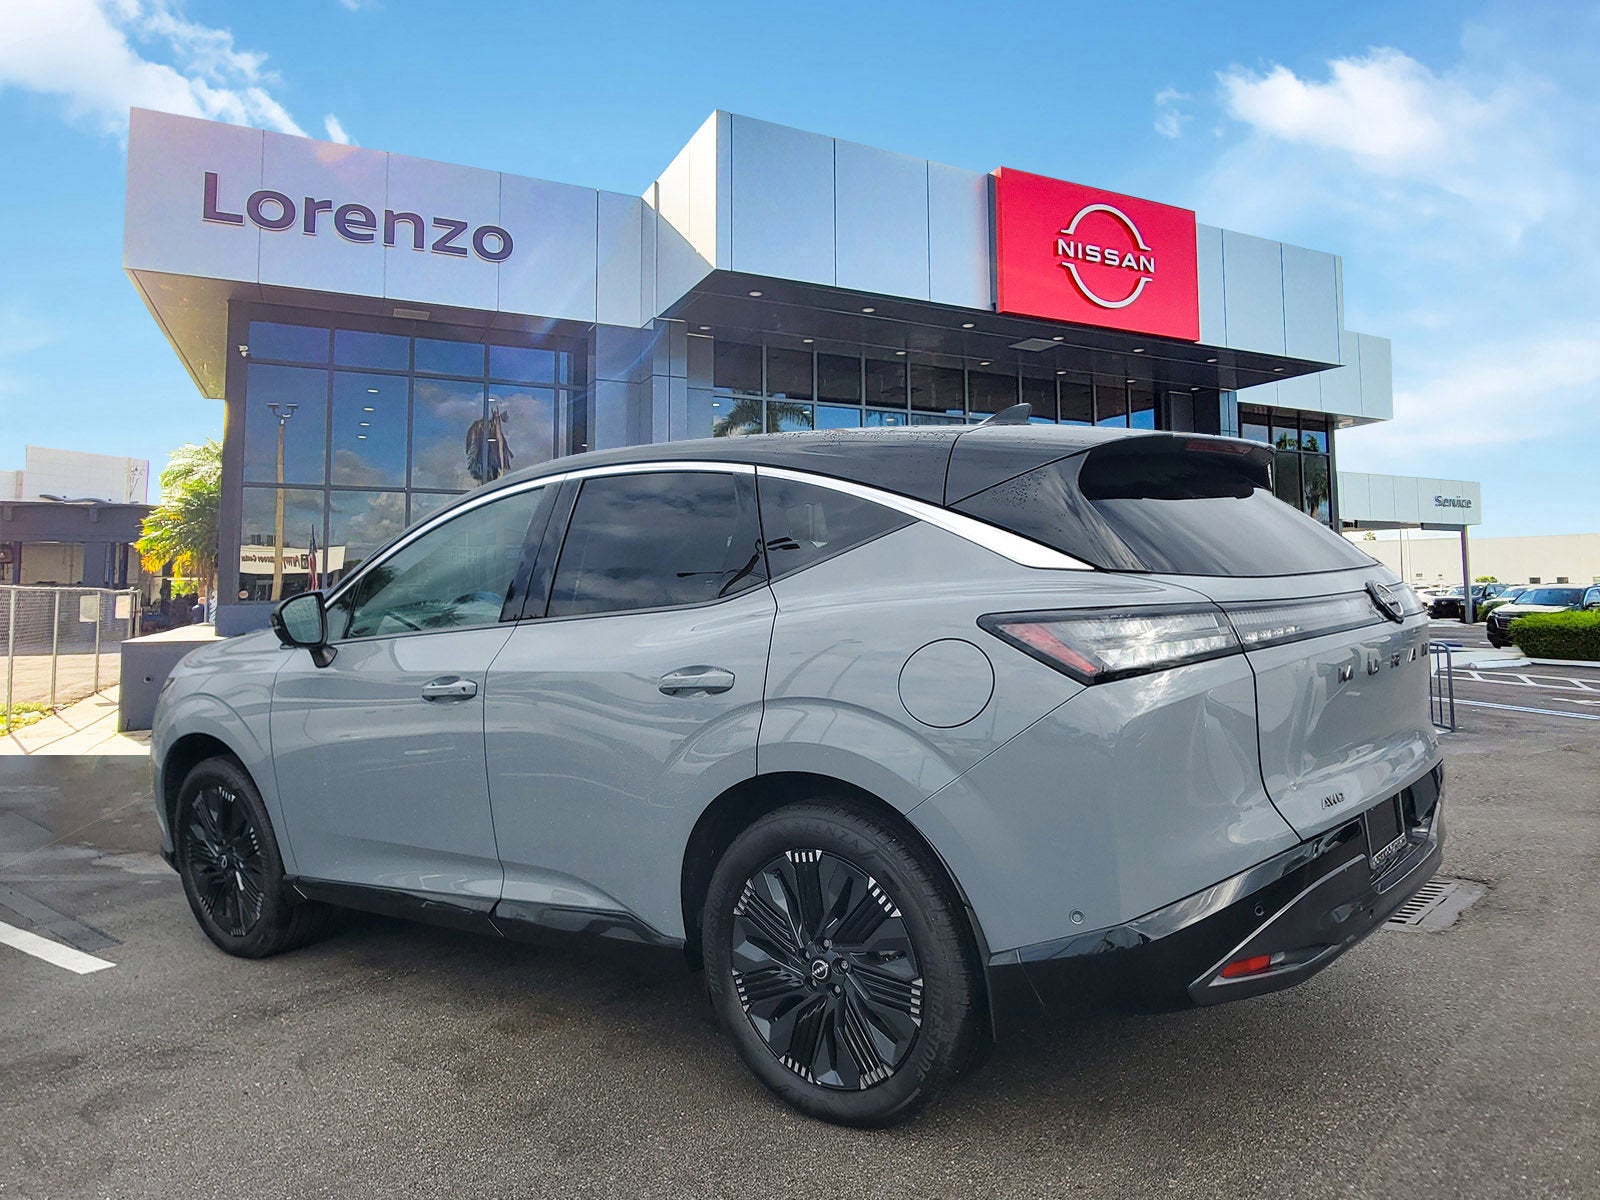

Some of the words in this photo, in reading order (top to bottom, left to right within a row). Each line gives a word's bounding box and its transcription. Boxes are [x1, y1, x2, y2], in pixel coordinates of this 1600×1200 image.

[202, 171, 514, 262] Lorenzo
[1058, 238, 1155, 273] NISSAN
[1434, 495, 1472, 508] Service
